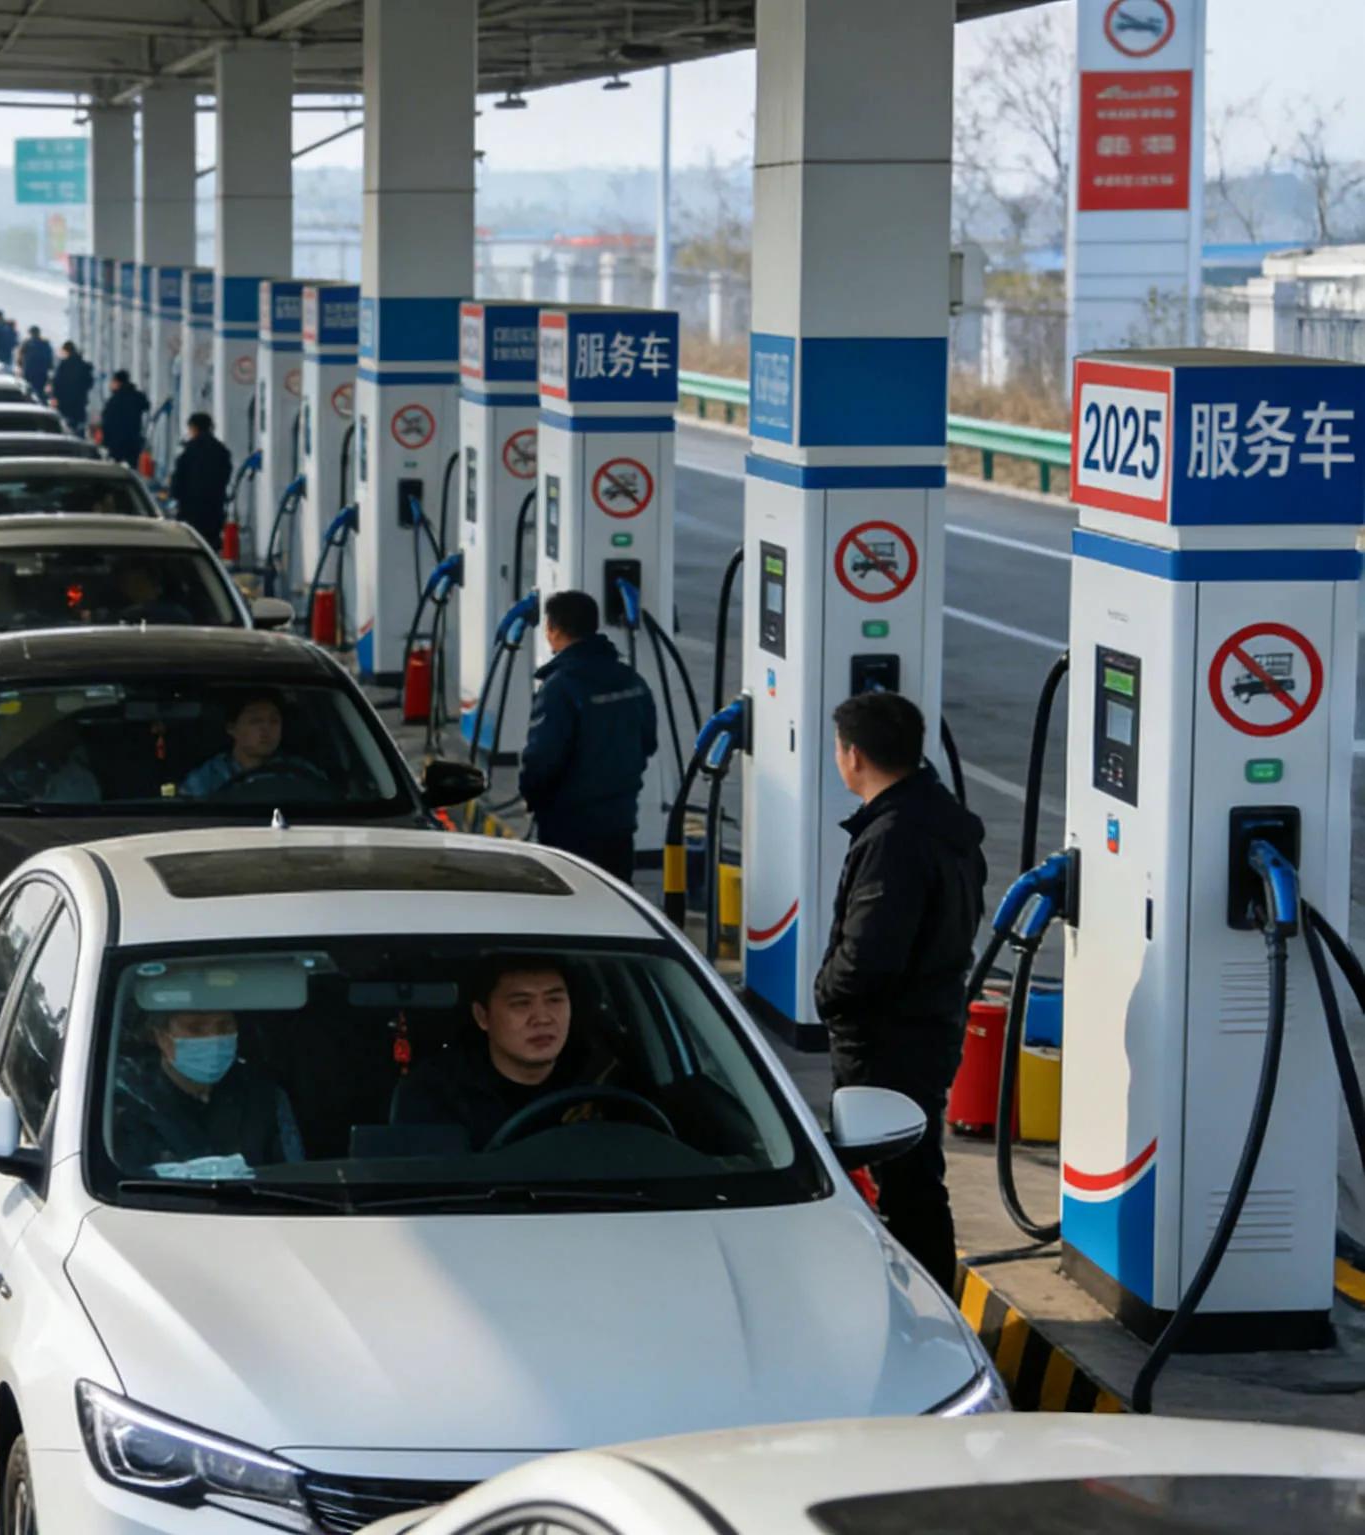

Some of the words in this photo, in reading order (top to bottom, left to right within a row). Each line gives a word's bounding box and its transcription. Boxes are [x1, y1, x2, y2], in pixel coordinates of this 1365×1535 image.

[574, 331, 672, 379] 服务车
[1082, 402, 1162, 479] 2025
[1187, 400, 1355, 480] 服务车
